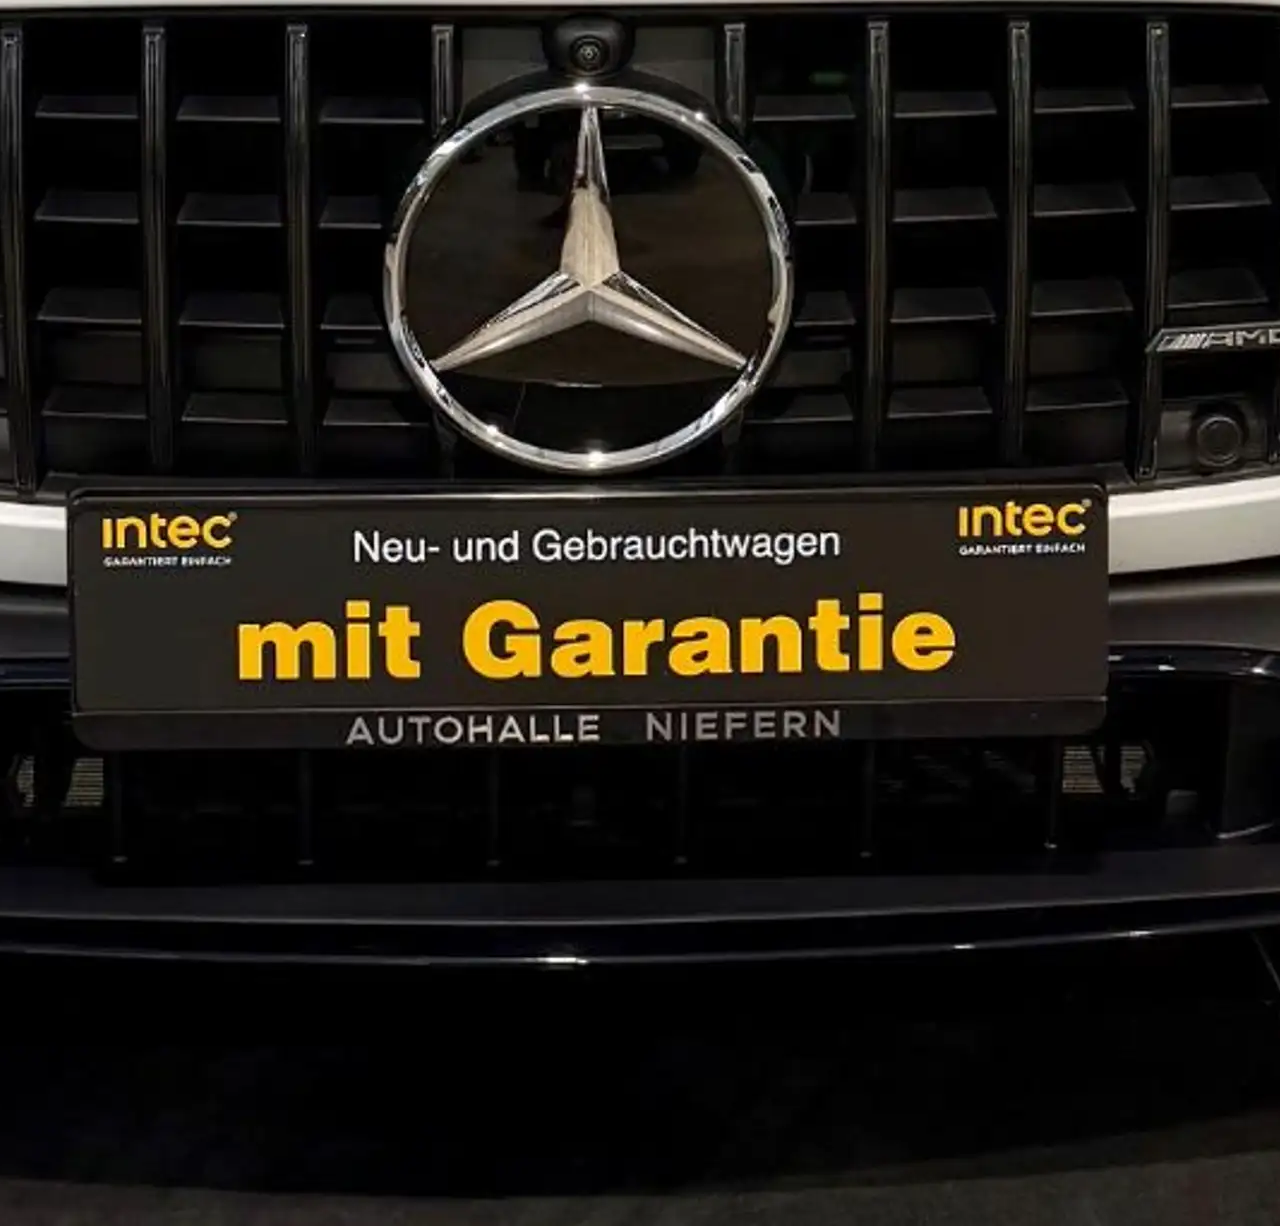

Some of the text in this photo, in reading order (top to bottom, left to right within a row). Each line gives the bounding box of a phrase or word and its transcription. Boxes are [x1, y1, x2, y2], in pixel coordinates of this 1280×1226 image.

[353, 527, 840, 566] Neu- und Gebrauchtwagen
[958, 541, 1086, 556] GARANTIERT EINFACH
[237, 592, 956, 680] mit Garantie
[346, 709, 840, 745] AUTOHALLE NIEFERN
